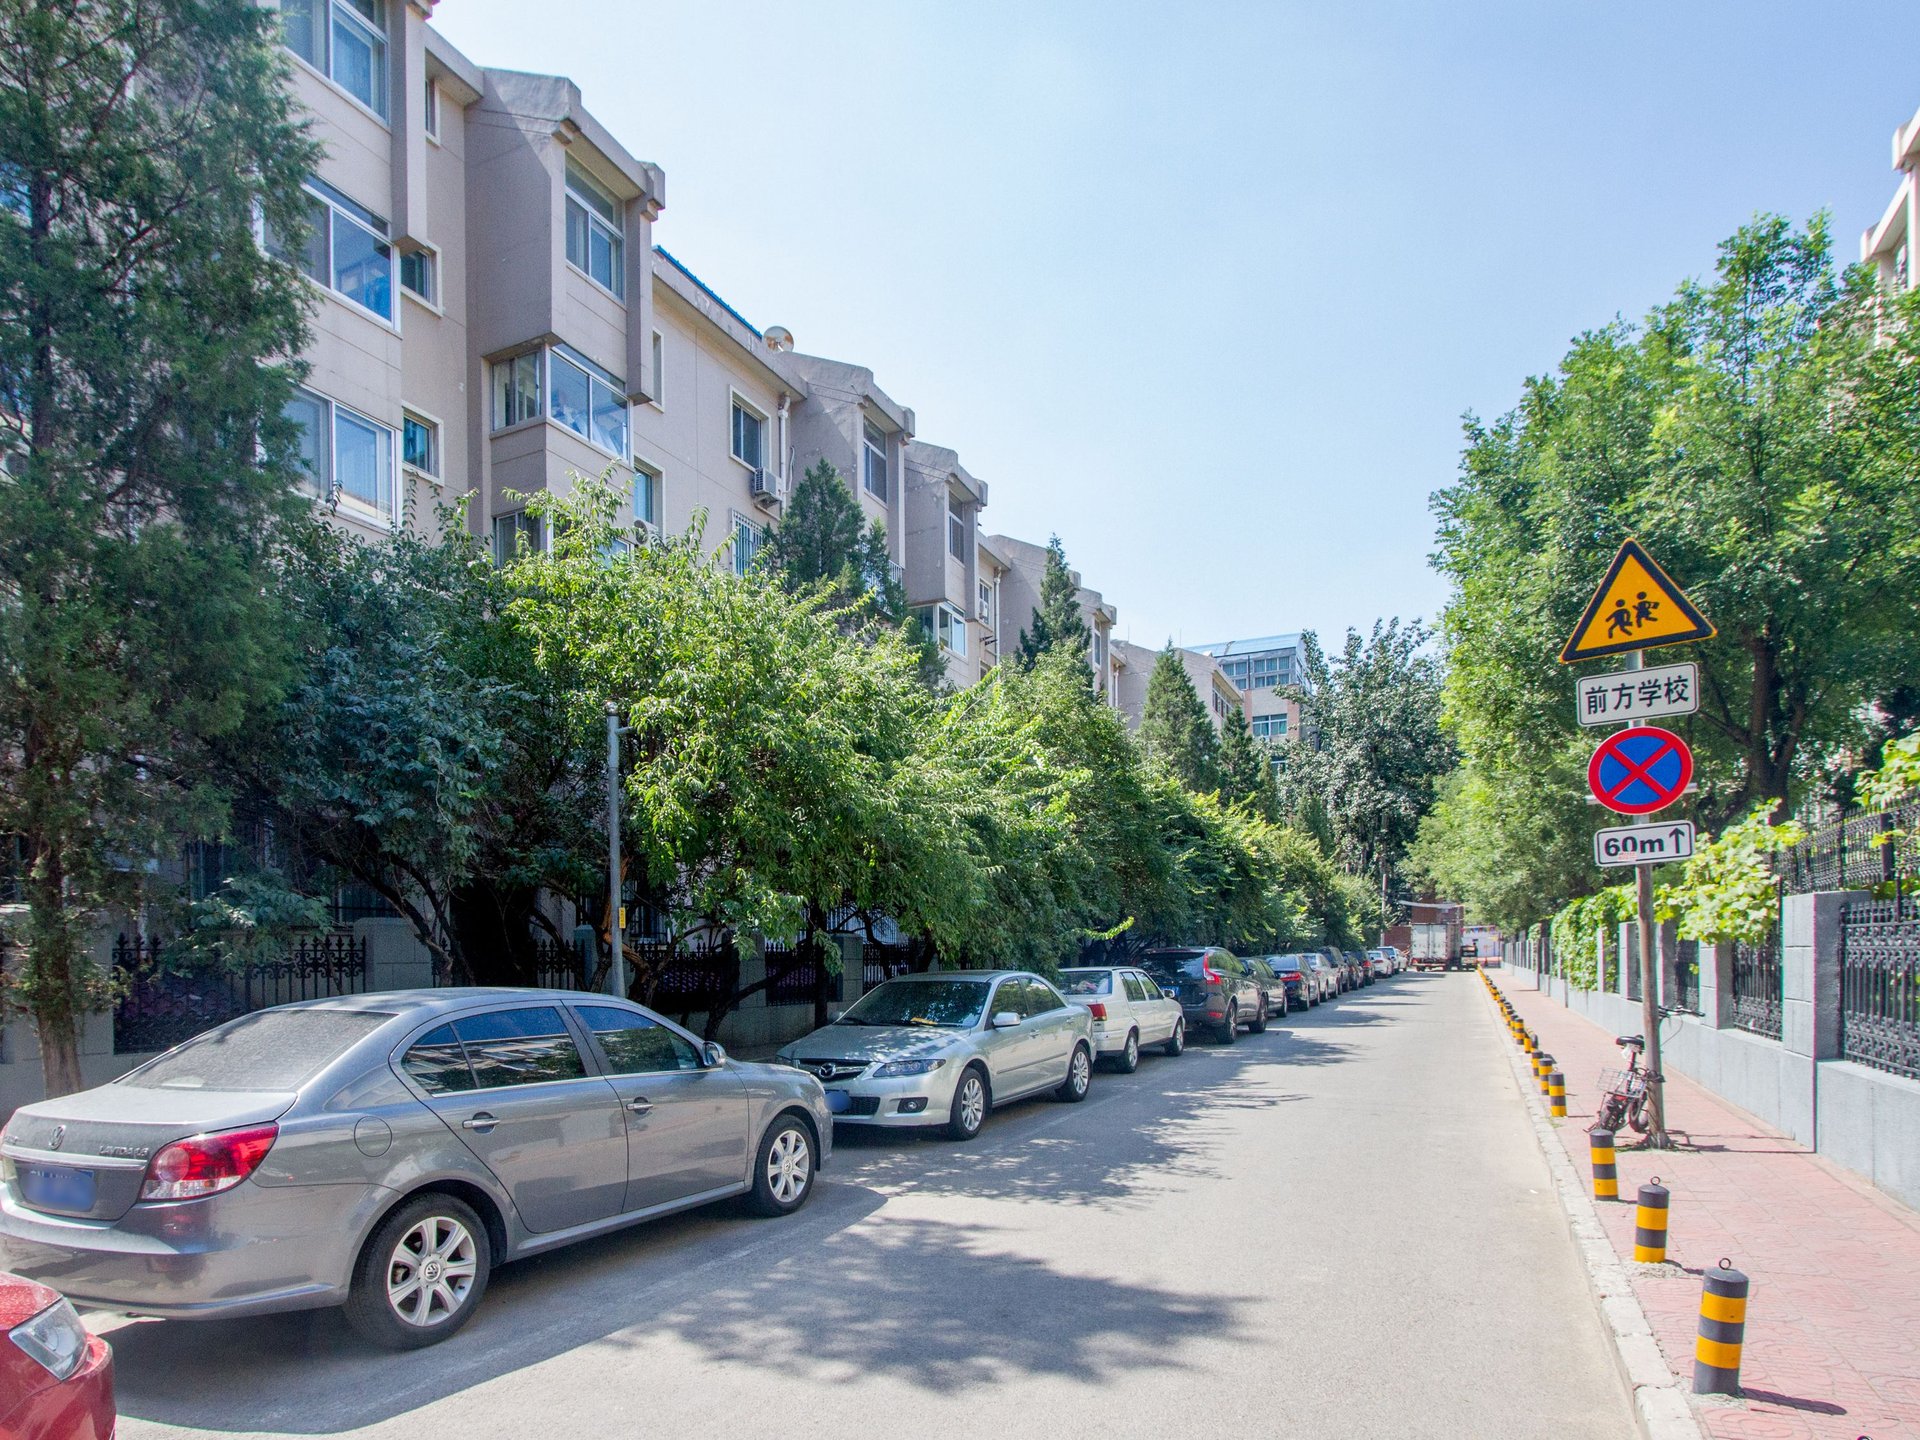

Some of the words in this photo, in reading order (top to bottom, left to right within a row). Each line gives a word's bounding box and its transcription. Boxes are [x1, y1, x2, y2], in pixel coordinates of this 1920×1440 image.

[1585, 675, 1689, 715] 前方学校
[1604, 836, 1664, 857] 60m
